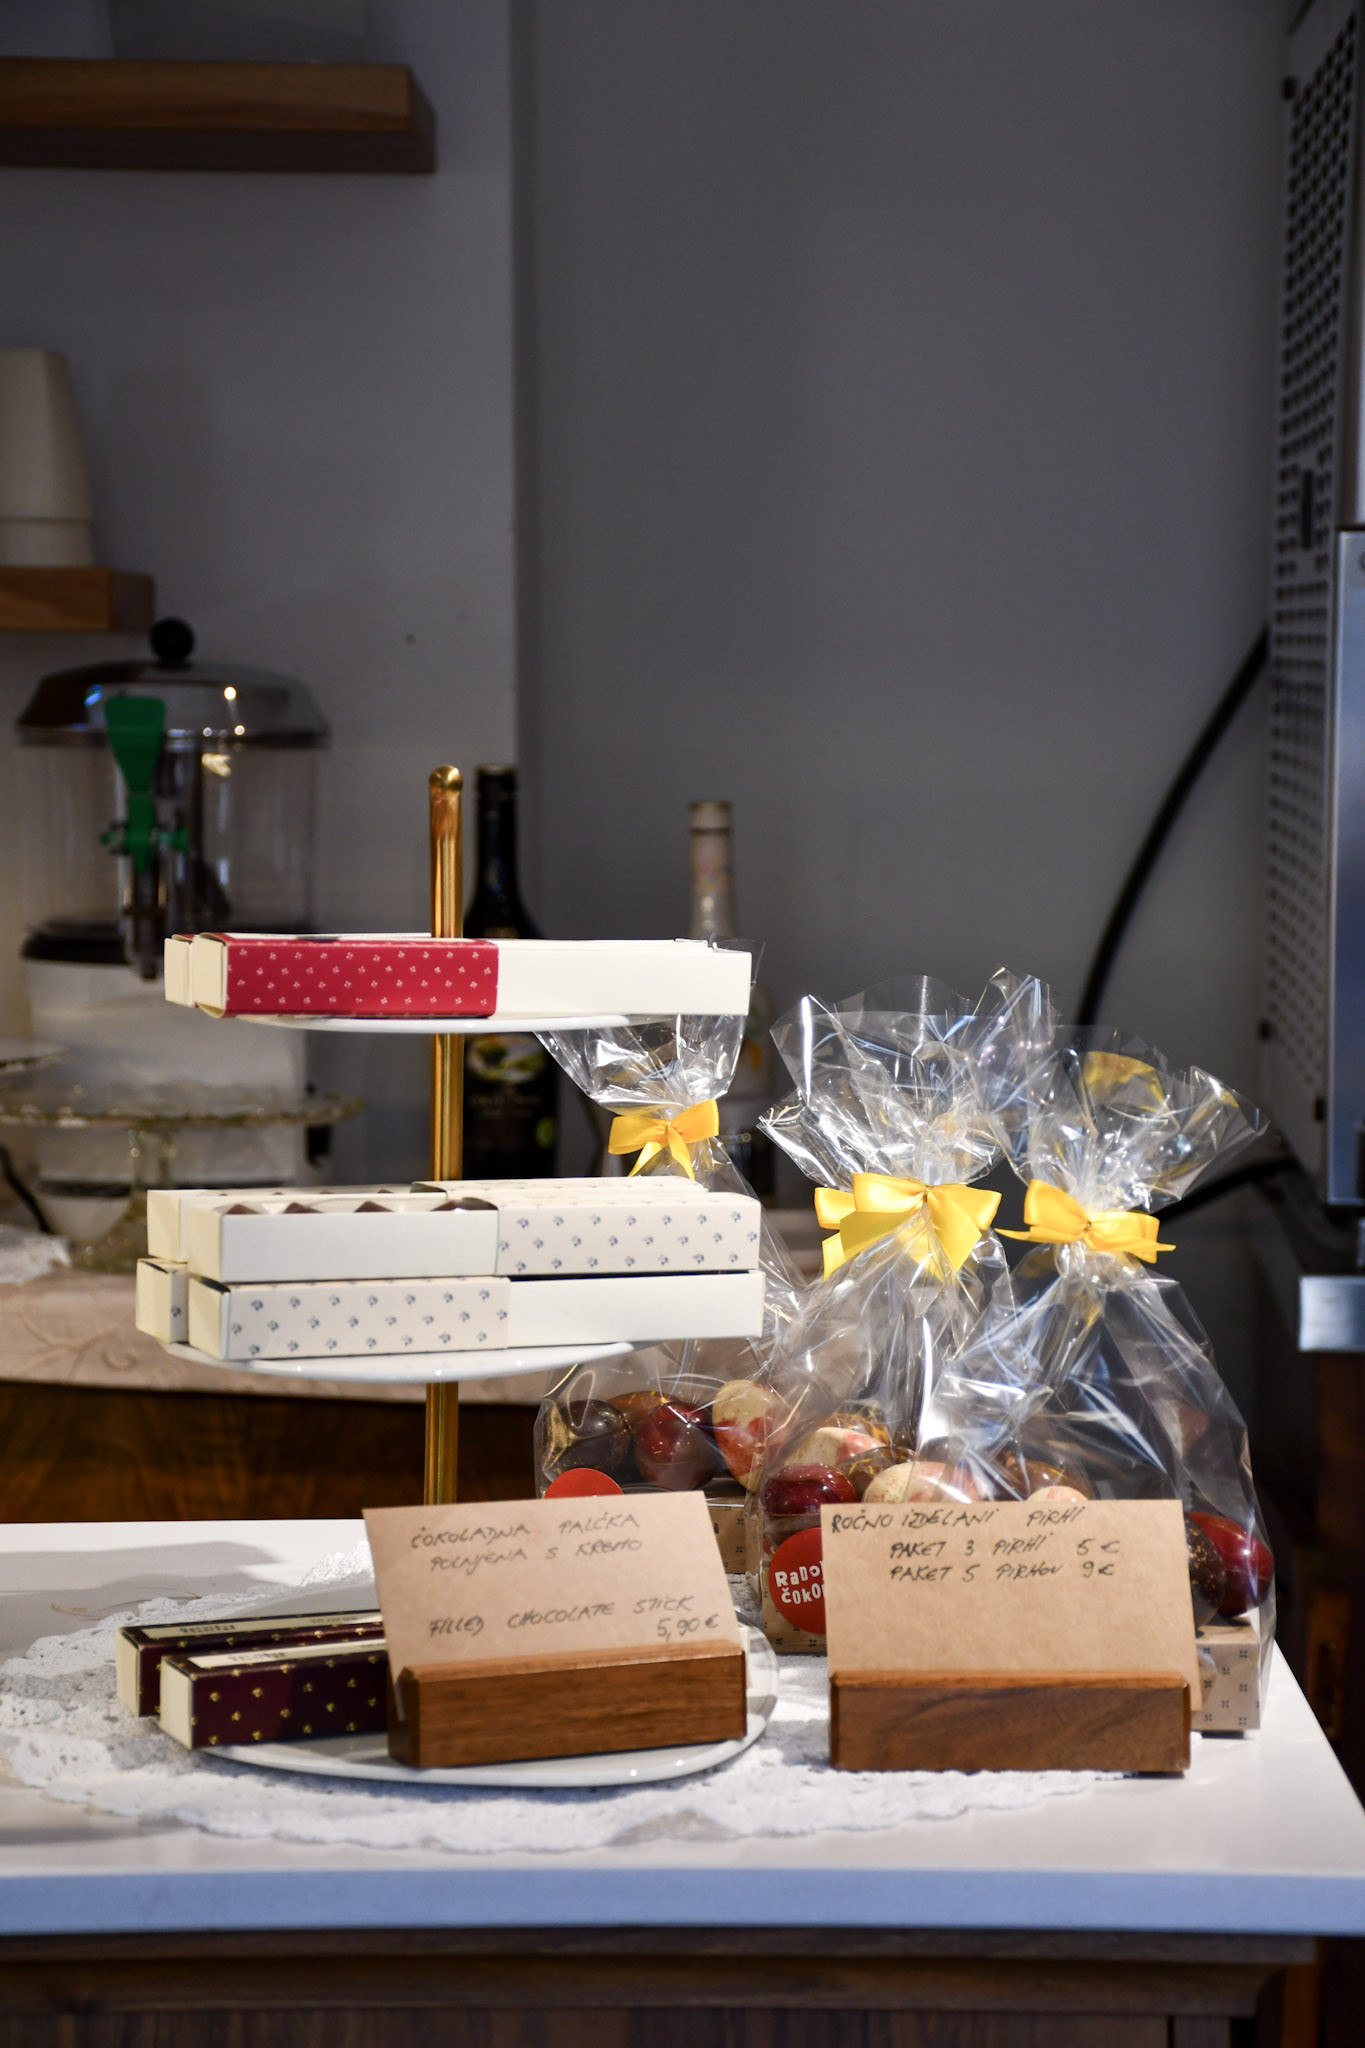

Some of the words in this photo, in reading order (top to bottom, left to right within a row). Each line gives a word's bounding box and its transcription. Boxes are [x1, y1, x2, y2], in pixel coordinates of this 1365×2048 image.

[890, 1540, 946, 1559] PAKET
[964, 1540, 975, 1556] 3
[890, 1564, 952, 1582] PAKET
[962, 1564, 981, 1583] 5
[429, 1614, 485, 1638] FILLED
[507, 1602, 616, 1629] CHOCOLATE
[632, 1595, 695, 1614] STICK
